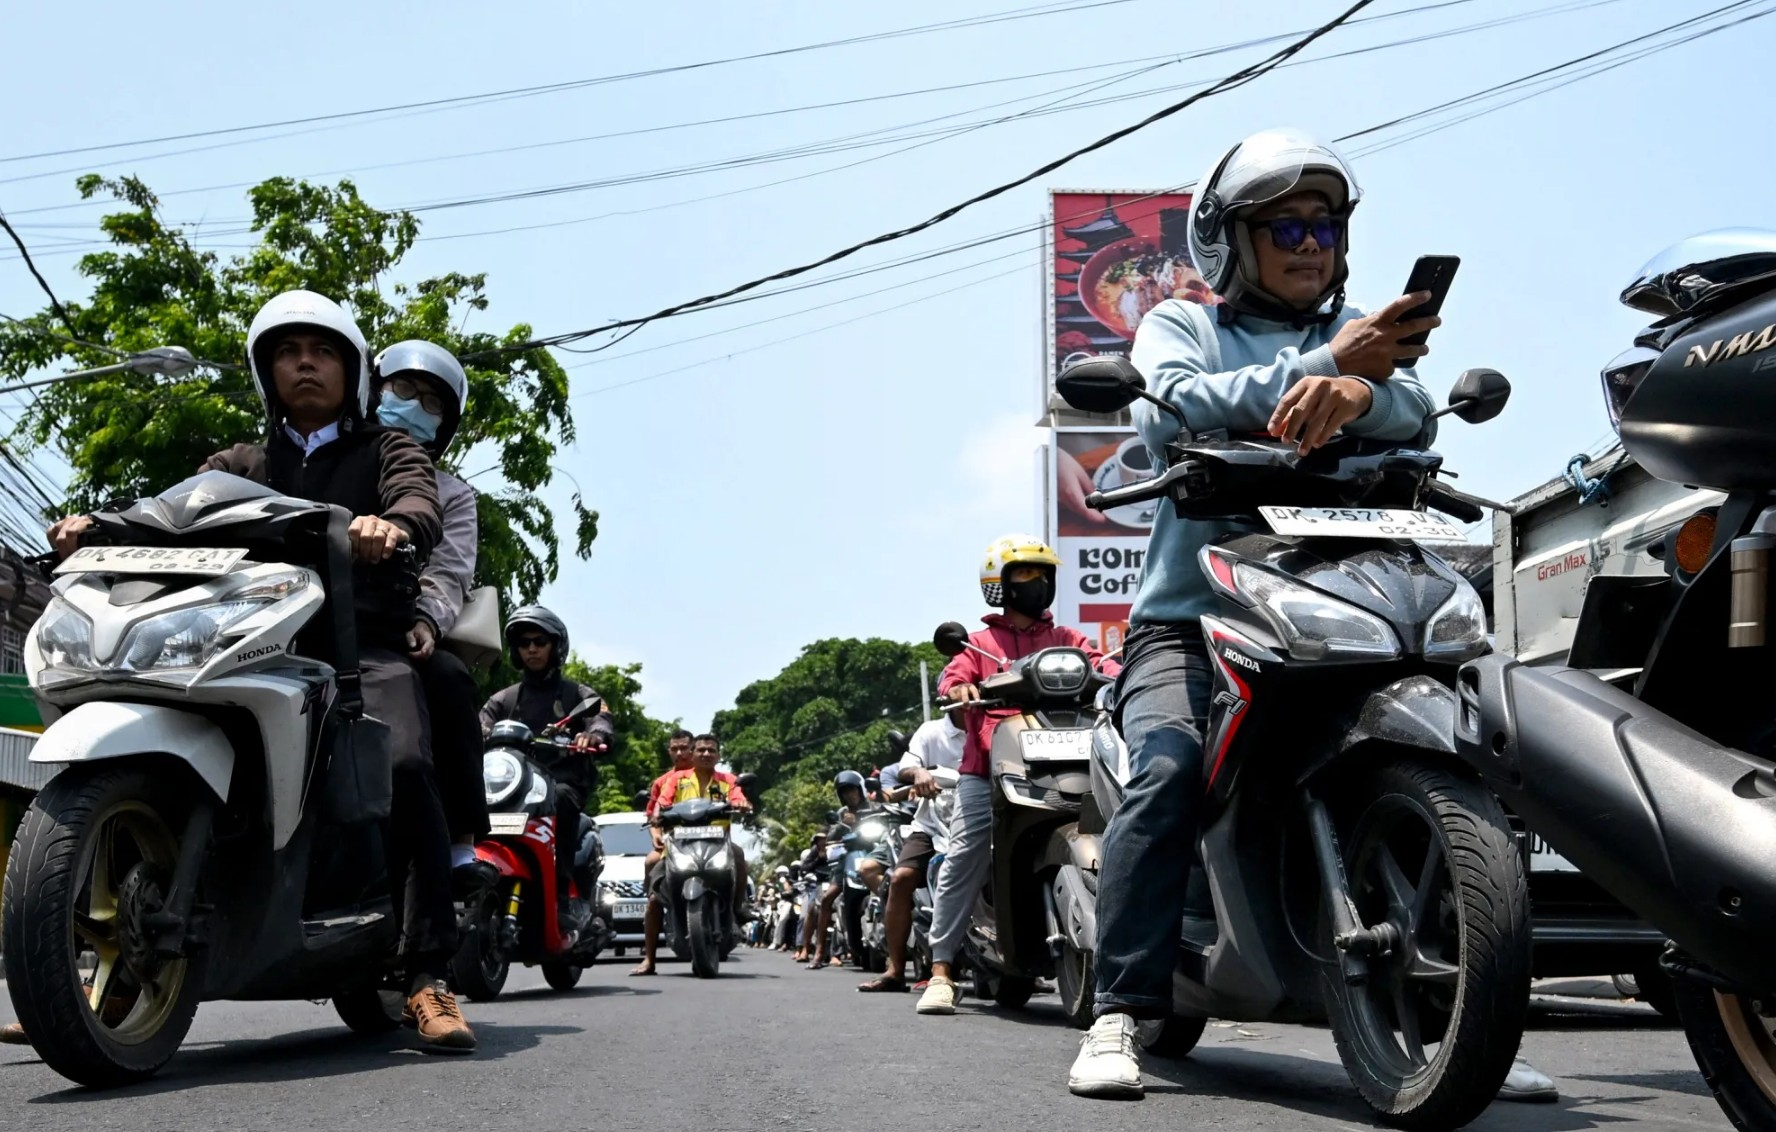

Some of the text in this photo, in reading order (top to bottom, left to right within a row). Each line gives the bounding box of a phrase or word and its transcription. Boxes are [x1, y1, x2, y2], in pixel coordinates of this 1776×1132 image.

[1270, 507, 1303, 520] DK
[1322, 509, 1394, 522] 2578
[74, 548, 111, 560] DK
[1537, 553, 1587, 582] Gran Max
[1079, 573, 1138, 595] Cof
[237, 643, 282, 663] HONDA
[1224, 647, 1262, 674] HONDA
[1026, 733, 1044, 746] DK
[1048, 731, 1082, 744] 6107
